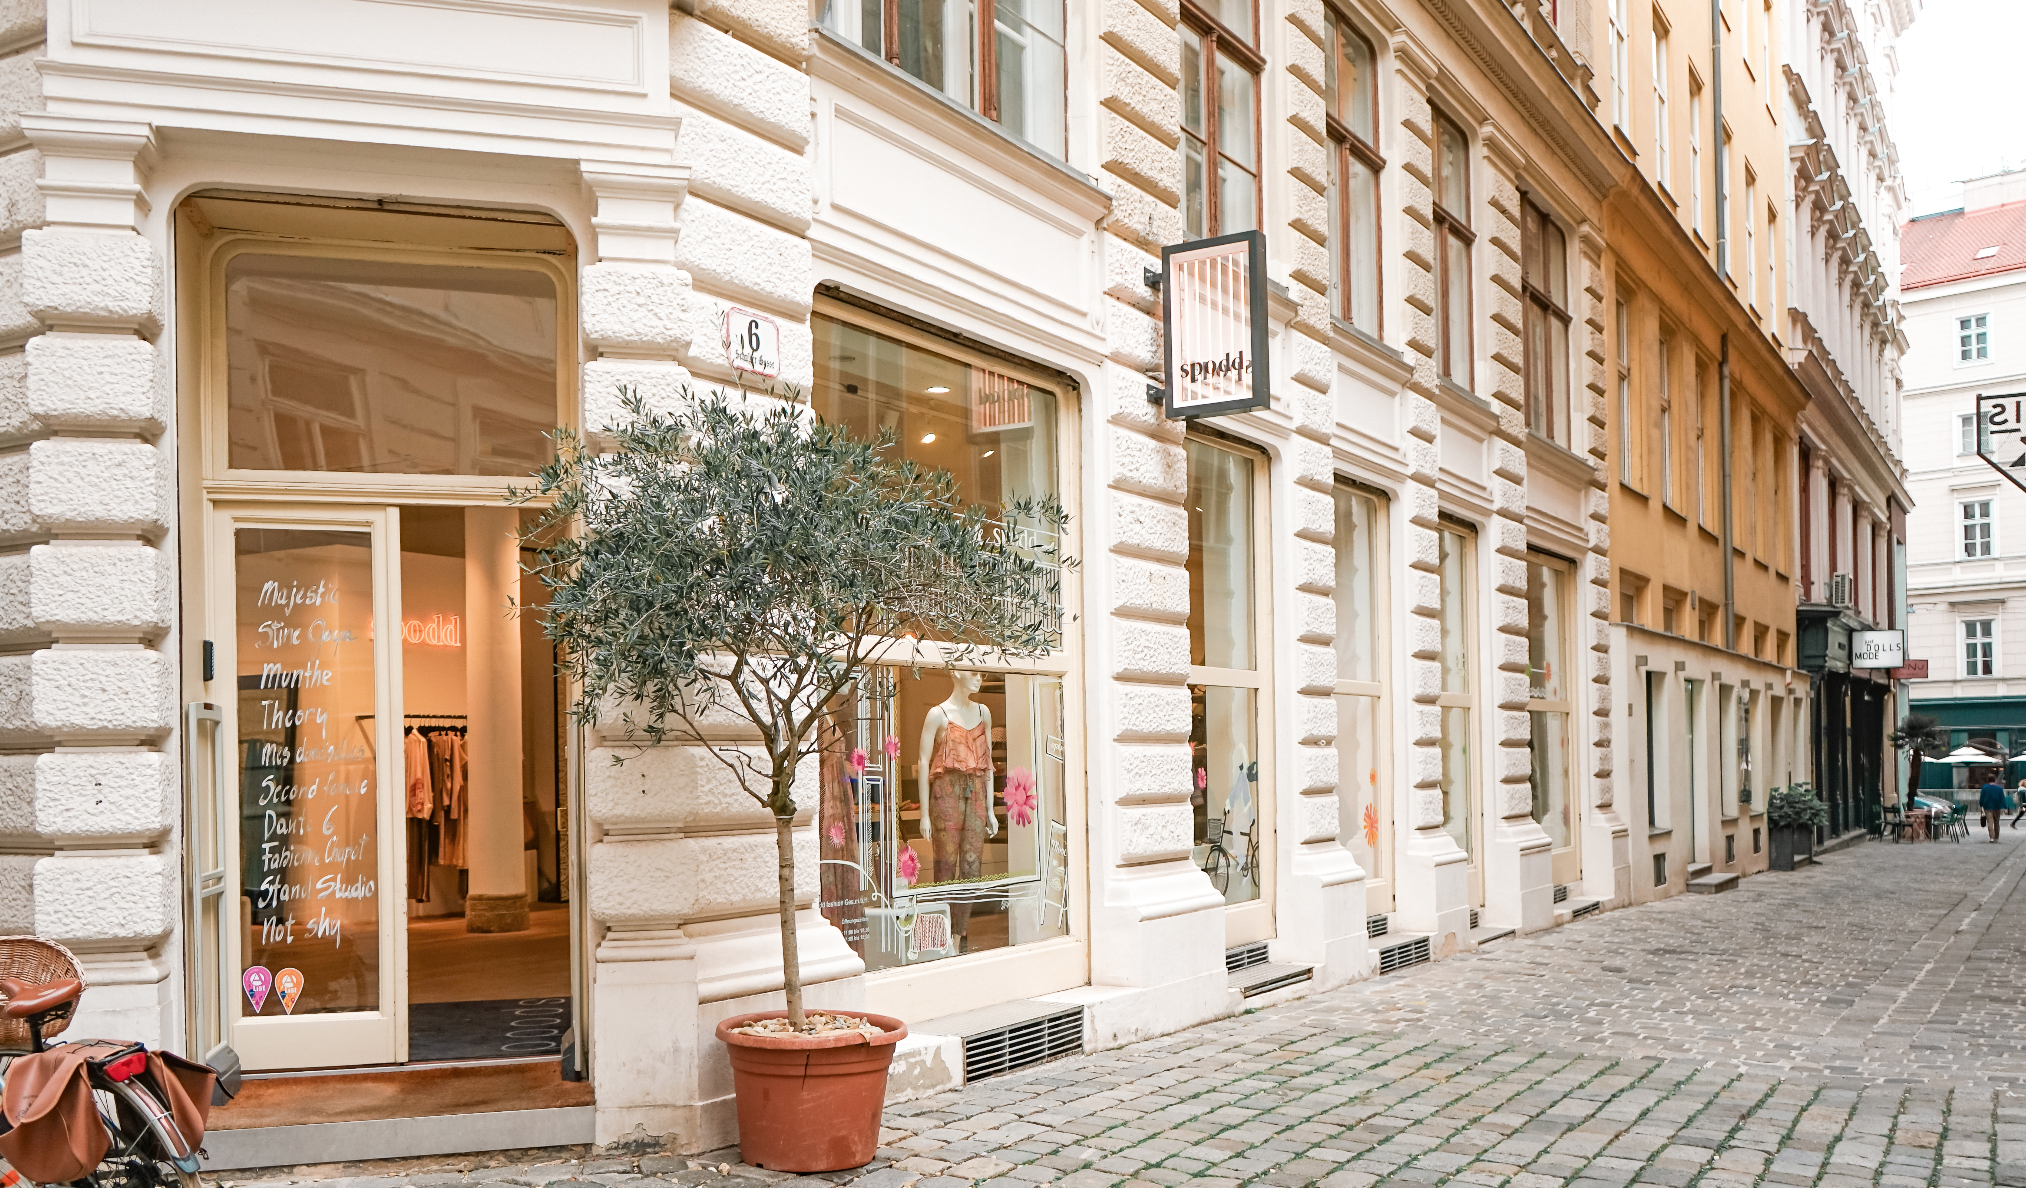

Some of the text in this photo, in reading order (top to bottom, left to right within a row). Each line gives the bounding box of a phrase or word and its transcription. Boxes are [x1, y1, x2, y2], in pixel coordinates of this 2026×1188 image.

[748, 319, 761, 352] 6
[1180, 350, 1244, 384] spodd
[257, 577, 341, 617] Majestic
[1854, 652, 1880, 661] MODE
[1866, 643, 1902, 653] DOLLS
[260, 659, 333, 691] Munthe
[261, 699, 328, 740] Theory
[258, 774, 320, 806] Second
[257, 873, 376, 909] Stand Studio
[304, 906, 342, 950] shy
